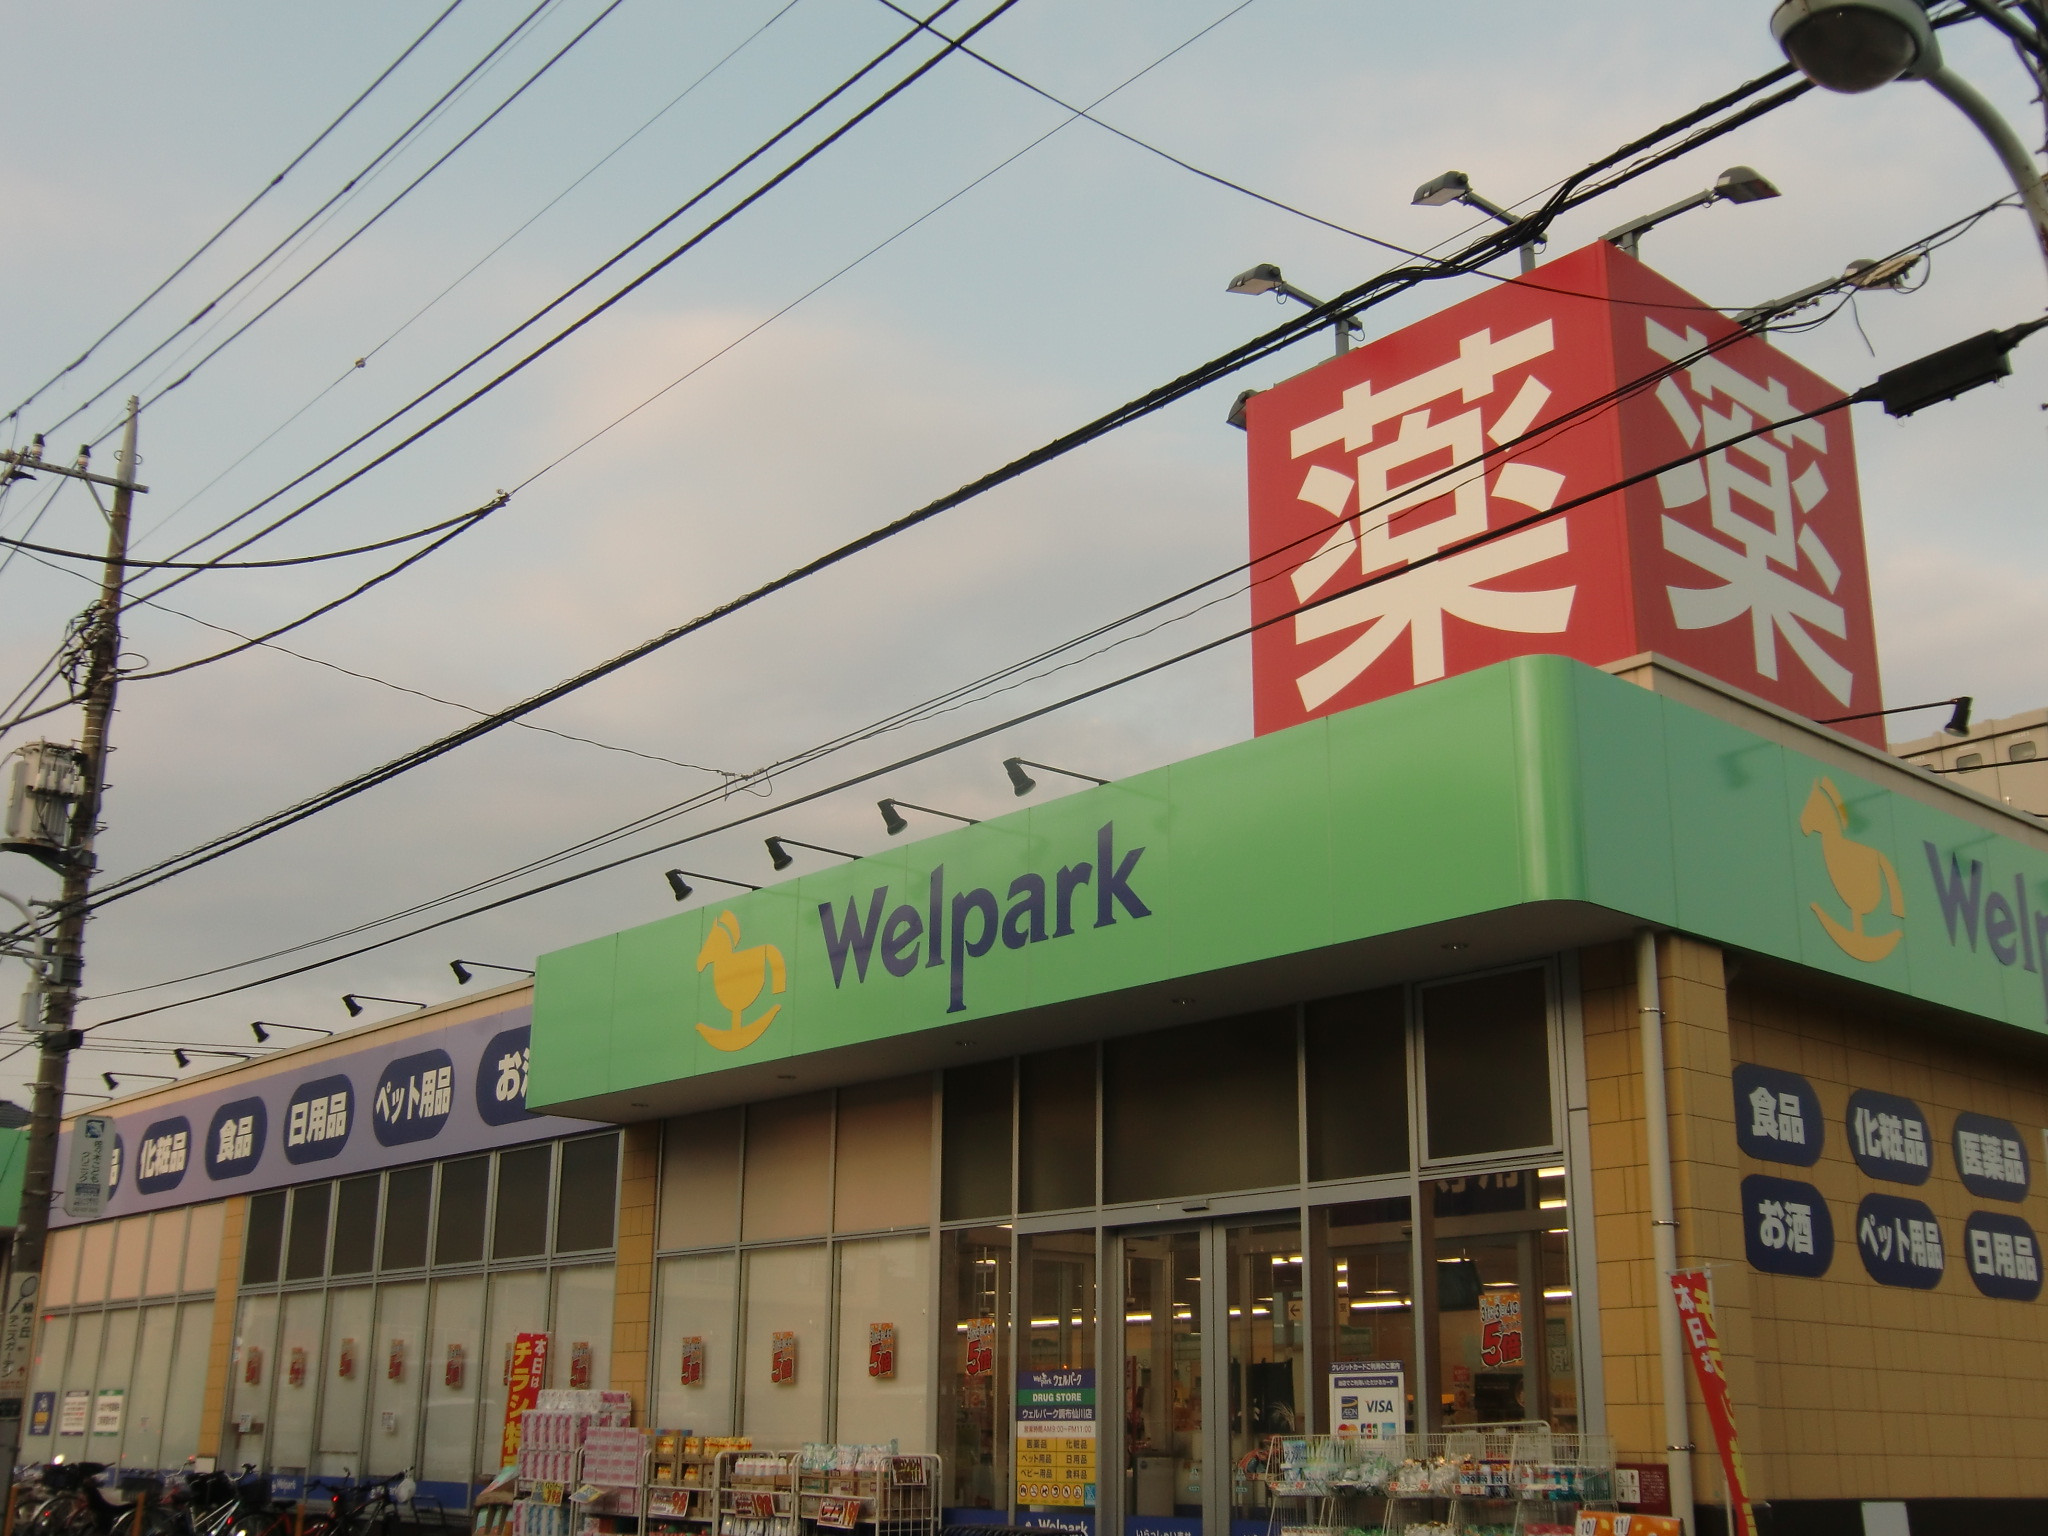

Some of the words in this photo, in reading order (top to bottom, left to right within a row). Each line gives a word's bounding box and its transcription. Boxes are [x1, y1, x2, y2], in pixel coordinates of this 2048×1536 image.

[1290, 317, 1577, 712] 薬
[1645, 316, 1854, 708] 薬
[817, 820, 1152, 1014] Welpark
[1922, 839, 2048, 1025] Wel
[288, 1091, 347, 1147] 日用品
[375, 1065, 452, 1125] ペット用品
[1748, 1086, 1806, 1145] 食品
[139, 1131, 188, 1180] 化粧品
[216, 1115, 254, 1164] 食品
[1854, 1107, 1929, 1168] 化粧品
[1957, 1130, 2026, 1185] 医薬品
[1758, 1199, 1815, 1256] お酒
[1859, 1215, 1944, 1270] ペット用品
[1970, 1229, 2039, 1282] 日用品
[530, 1339, 547, 1388] 本日は
[1481, 1320, 1522, 1367] 5倍
[1033, 1394, 1054, 1402] DRUG
[1055, 1393, 1082, 1402] STORE
[1365, 1400, 1394, 1413] VISA
[1021, 1454, 1052, 1464] ペット用品
[1066, 1454, 1087, 1464] 日用品
[1066, 1469, 1087, 1480] 食料品
